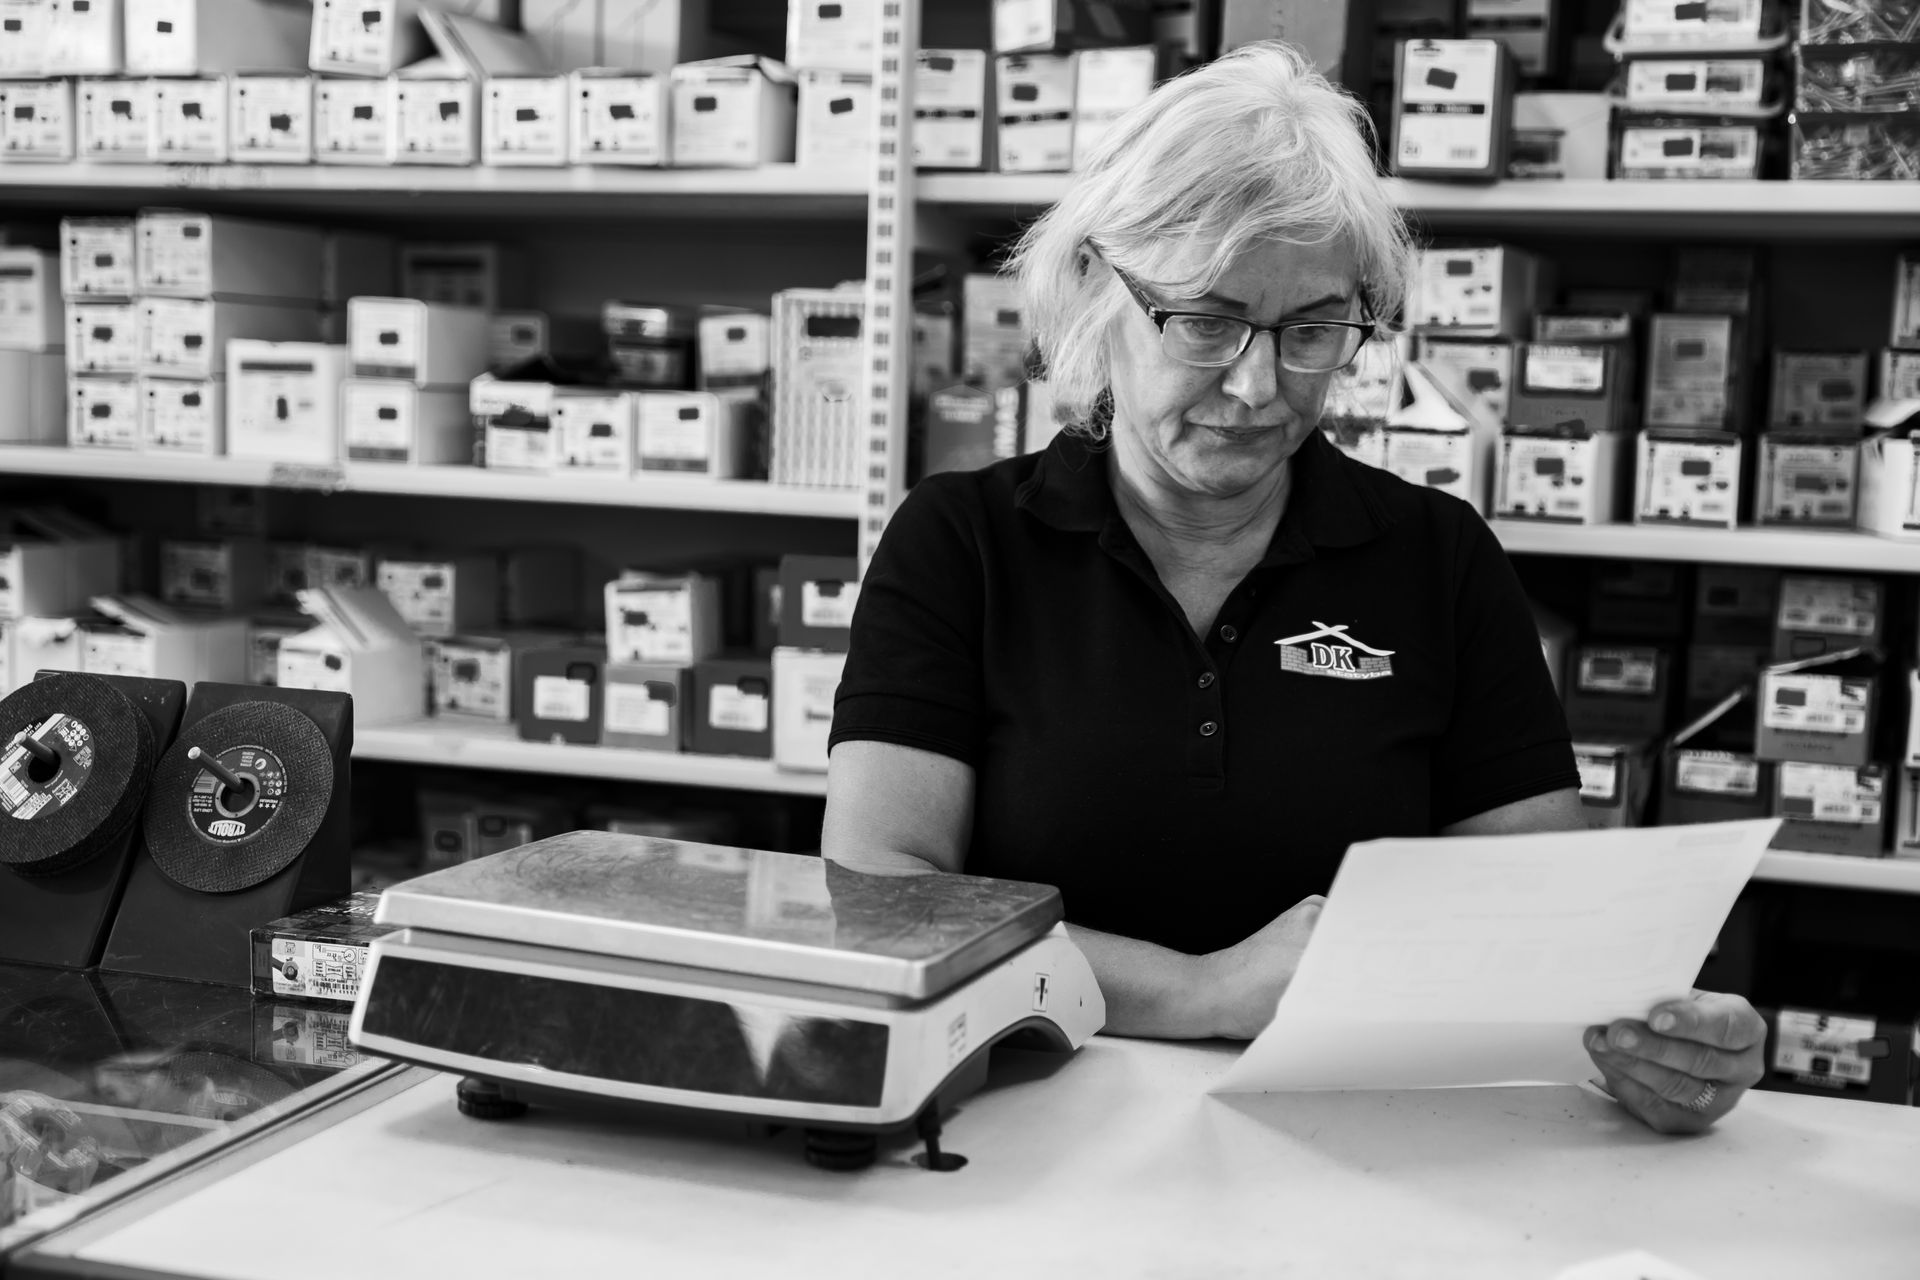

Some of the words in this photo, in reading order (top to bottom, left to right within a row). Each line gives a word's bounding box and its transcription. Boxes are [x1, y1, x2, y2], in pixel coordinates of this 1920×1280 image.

[1311, 642, 1356, 672] DK
[1326, 669, 1391, 679] statyba
[208, 820, 246, 836] TYROLIT
